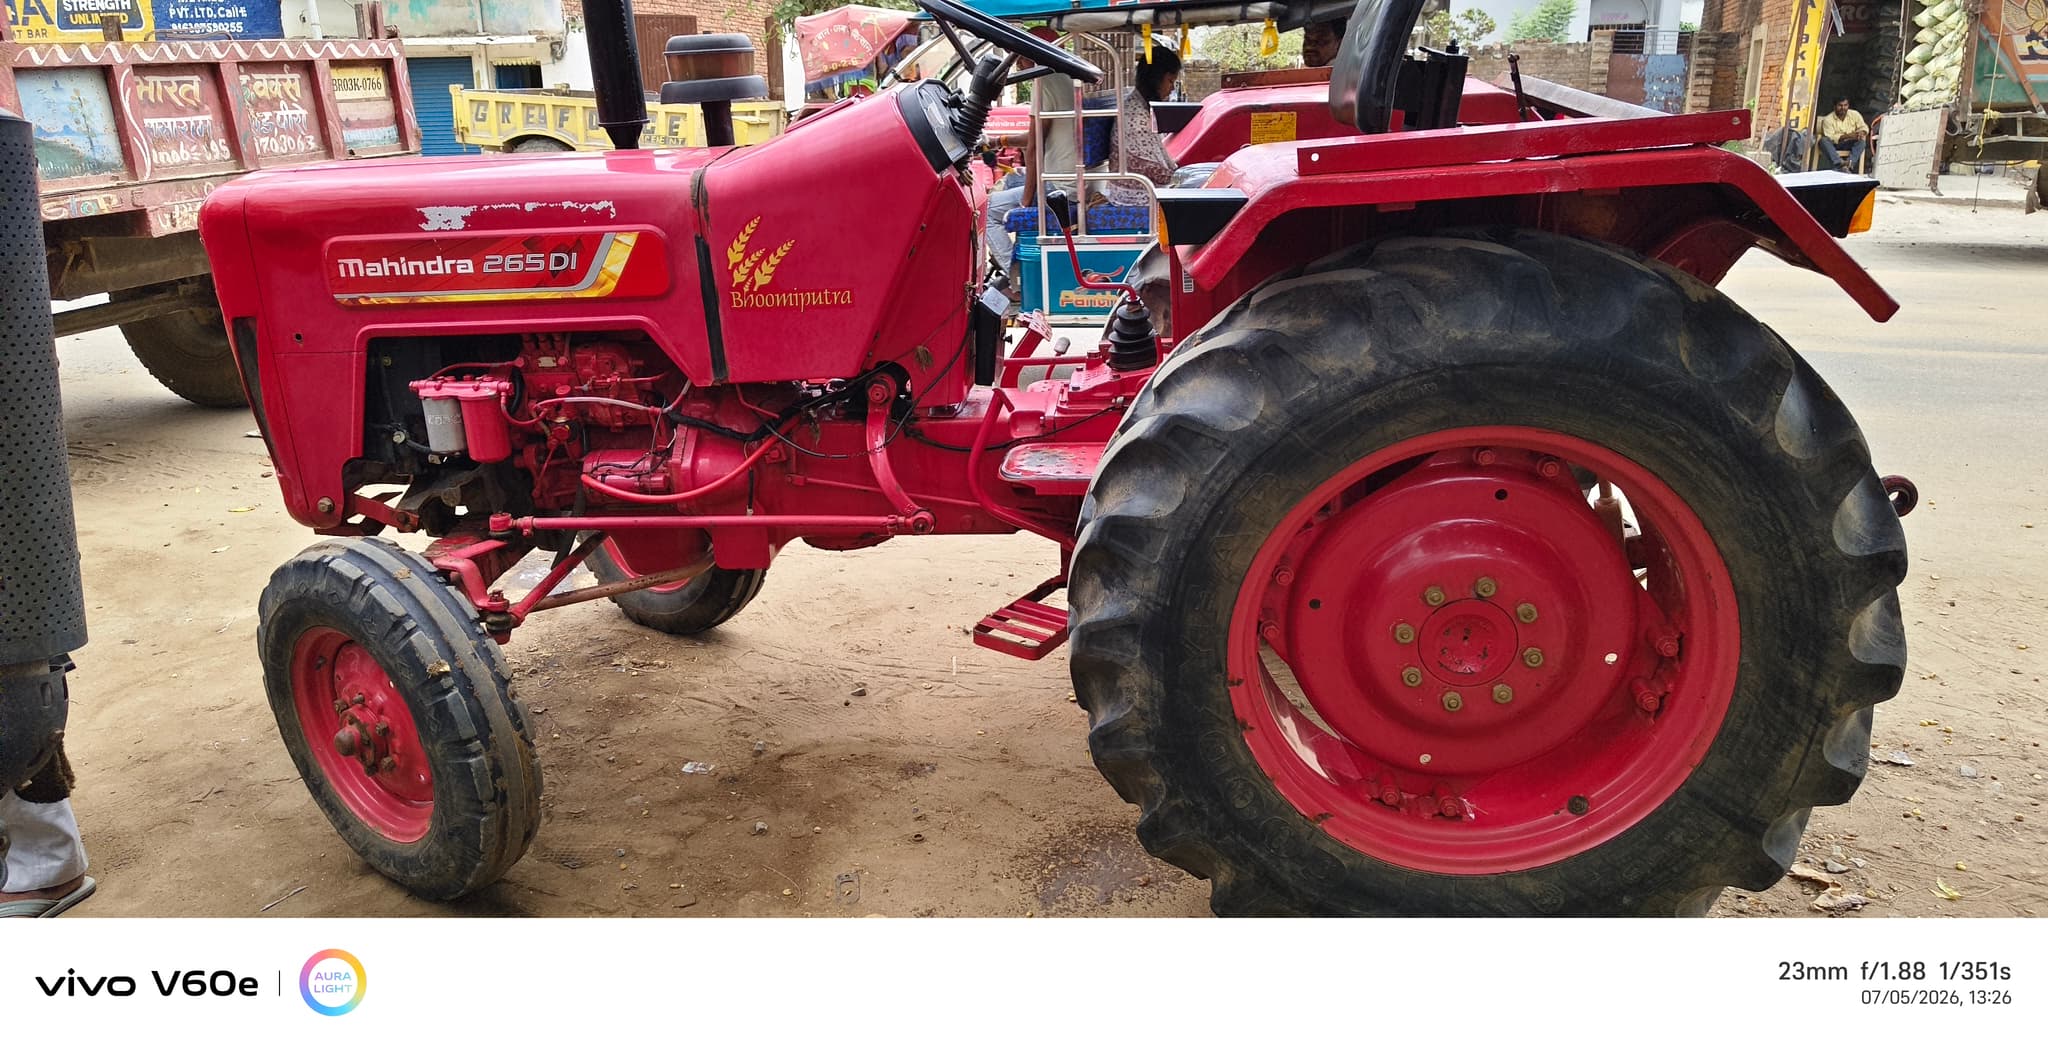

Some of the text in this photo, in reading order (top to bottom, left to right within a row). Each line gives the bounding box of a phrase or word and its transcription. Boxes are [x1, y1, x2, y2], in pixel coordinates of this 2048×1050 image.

[63, 0, 132, 12] STRENGTH
[27, 28, 48, 39] BAR
[135, 74, 202, 108] भारत
[331, 77, 382, 92] BR03K-0766
[338, 256, 475, 278] Mahindra
[729, 287, 853, 313] Bhoomiputra
